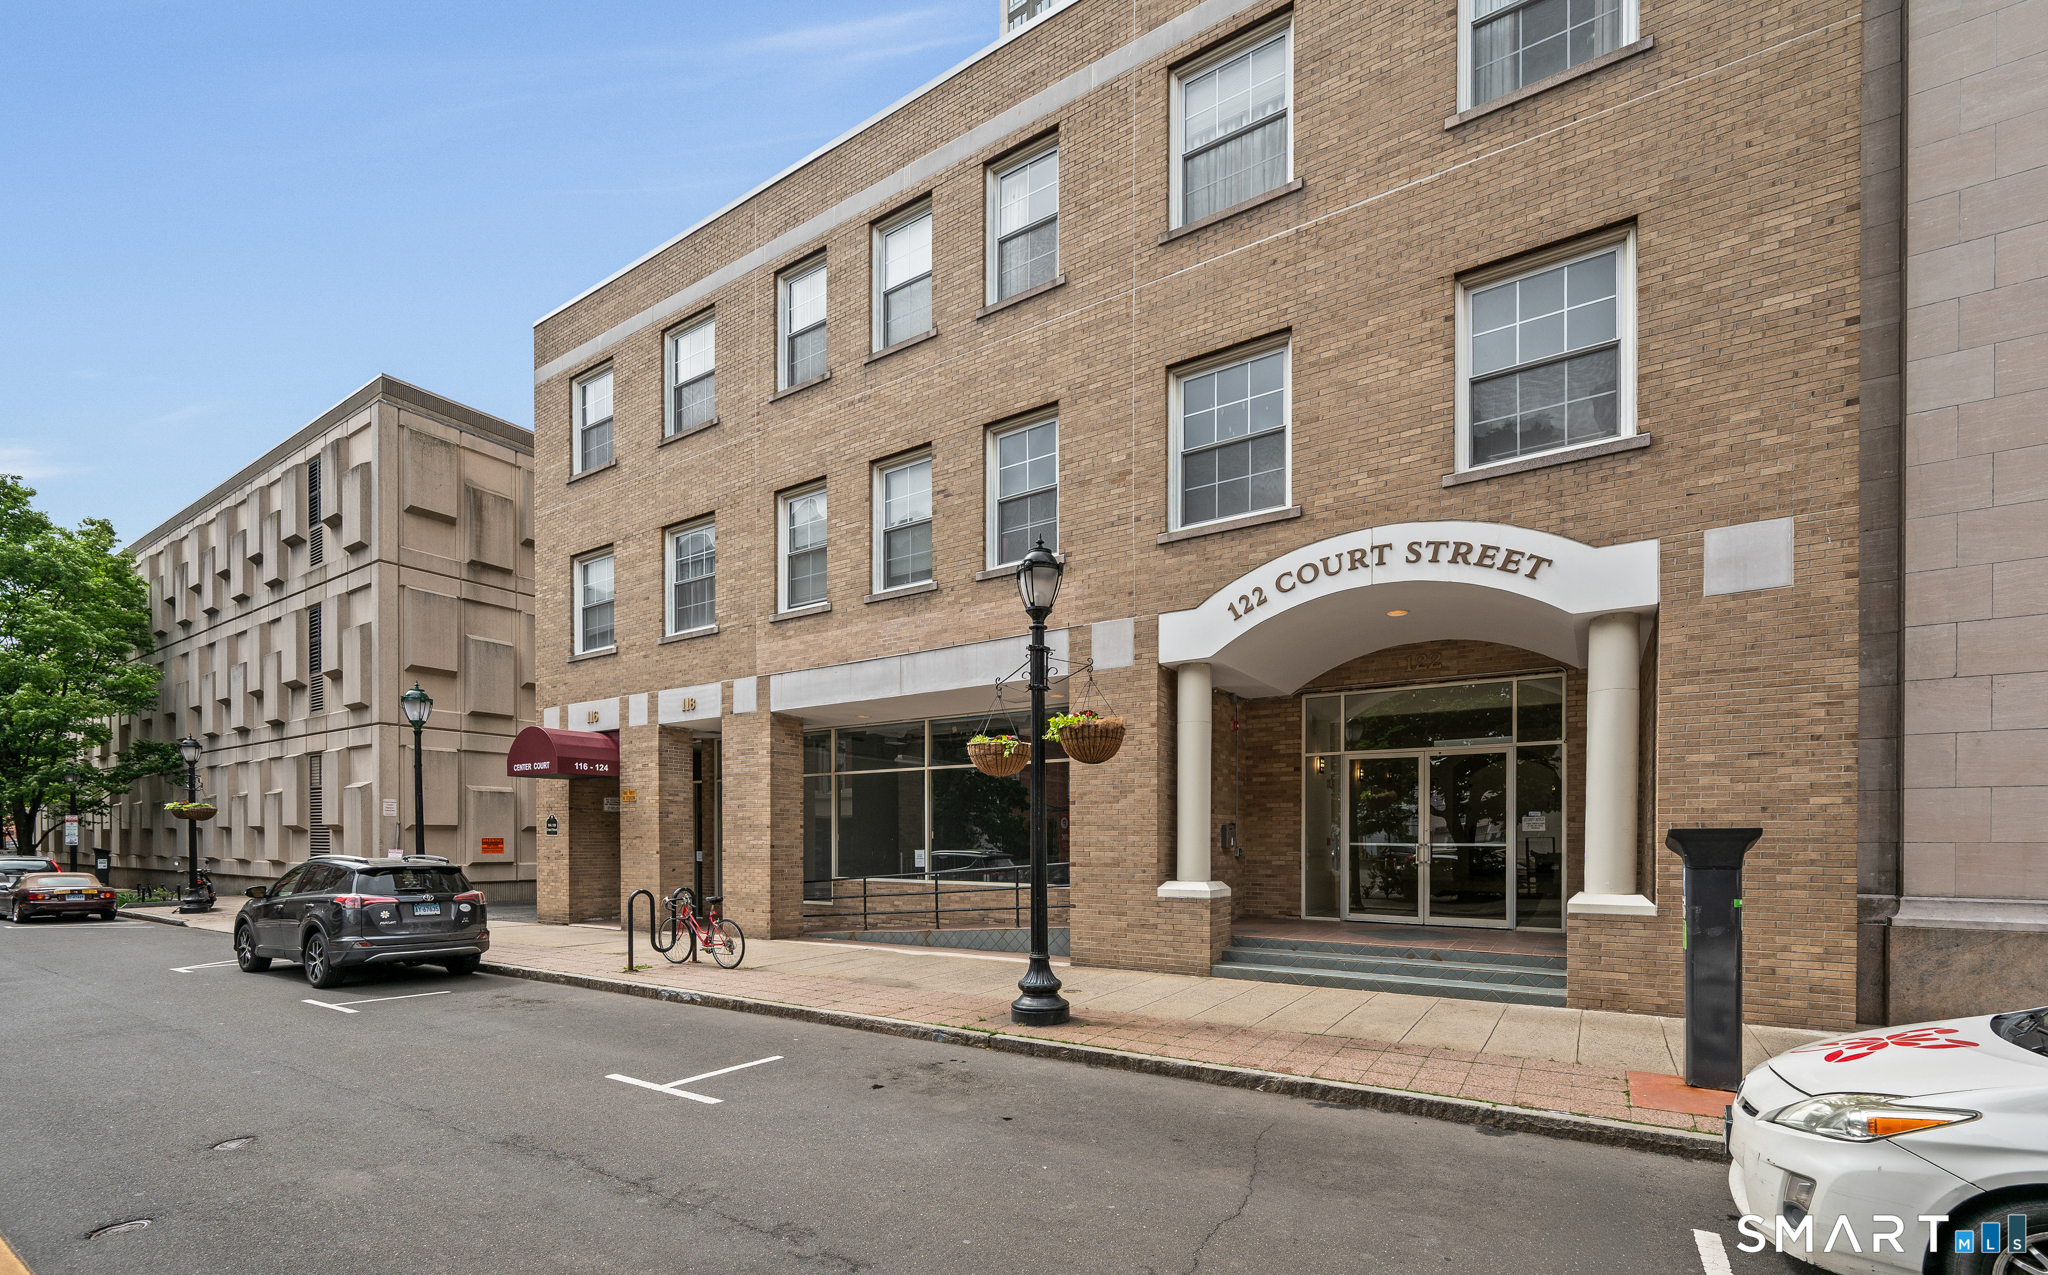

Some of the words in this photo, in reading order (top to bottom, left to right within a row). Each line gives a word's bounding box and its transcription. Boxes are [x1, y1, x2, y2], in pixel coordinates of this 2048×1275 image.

[1227, 586, 1268, 621] 122
[1275, 543, 1393, 593] COURT
[1405, 540, 1553, 580] STREET
[1405, 652, 1442, 672] 122
[587, 710, 599, 723] 116
[513, 763, 532, 772] CENTER
[533, 761, 551, 770] COURT
[574, 762, 588, 770] 116
